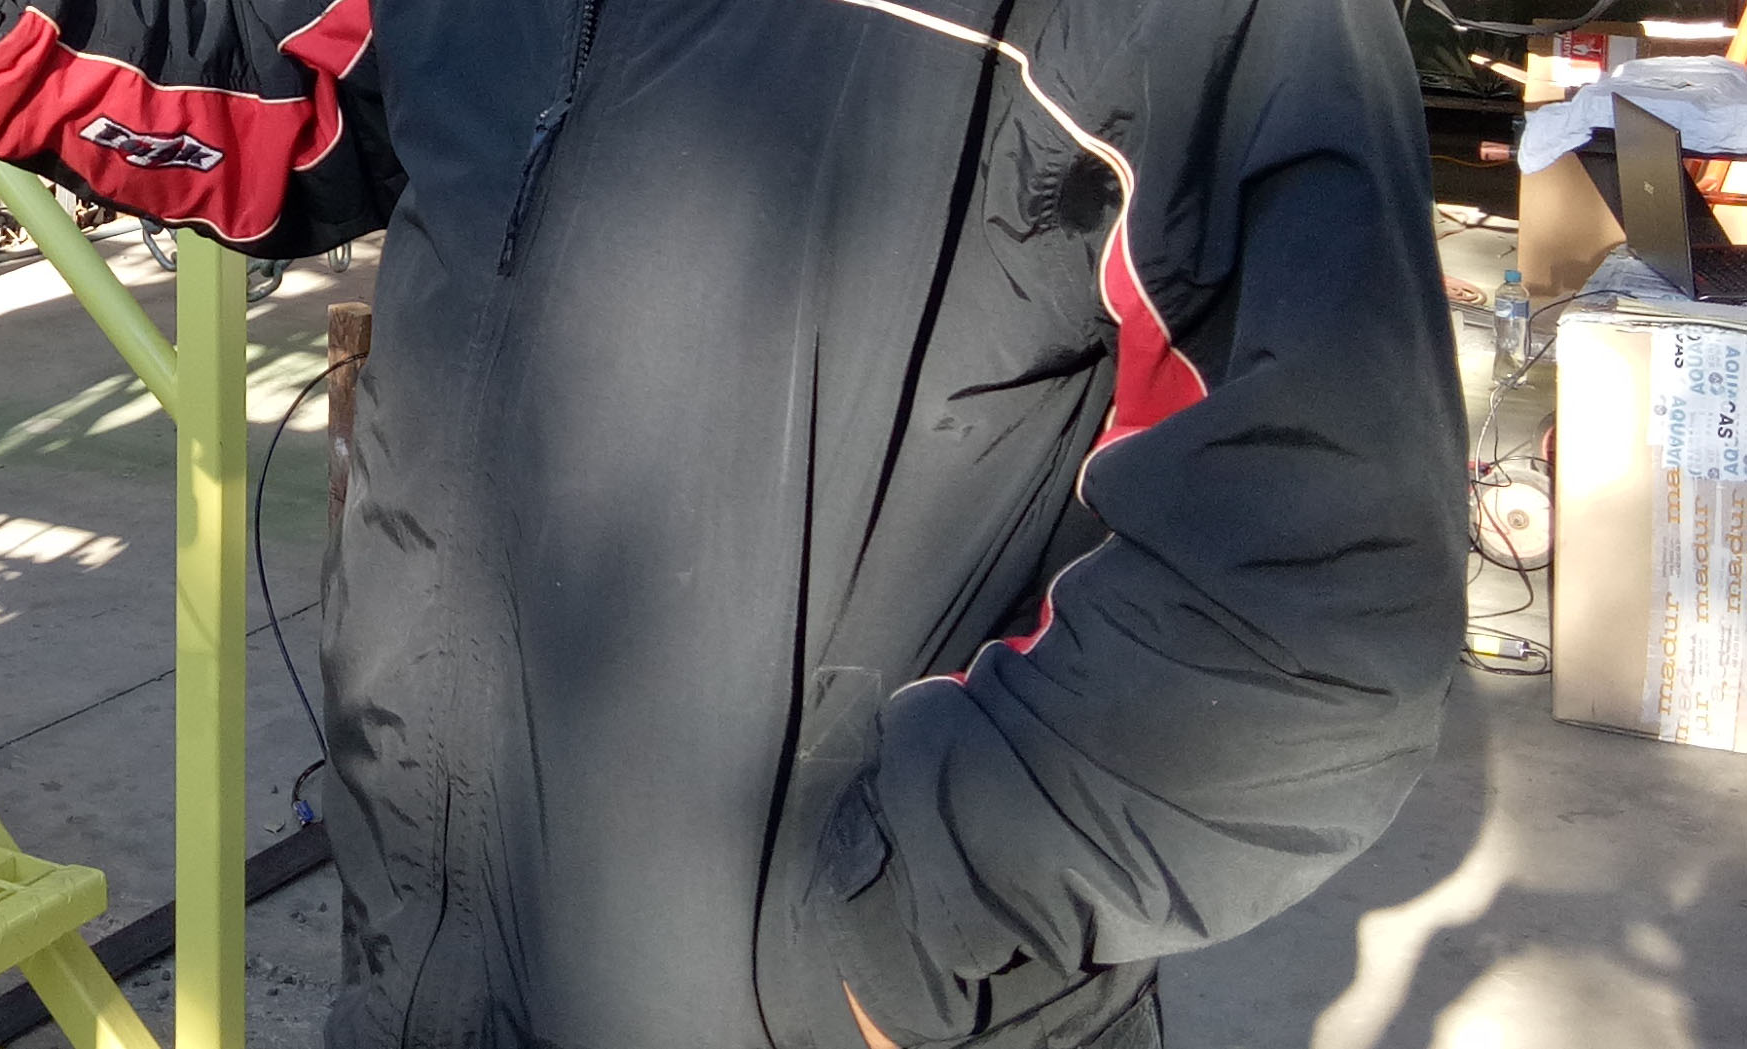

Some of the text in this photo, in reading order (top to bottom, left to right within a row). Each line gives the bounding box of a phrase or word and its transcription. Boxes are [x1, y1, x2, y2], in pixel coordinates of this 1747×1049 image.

[1693, 495, 1709, 623] madur
[1725, 488, 1745, 614] madur
[1659, 591, 1679, 715] madur
